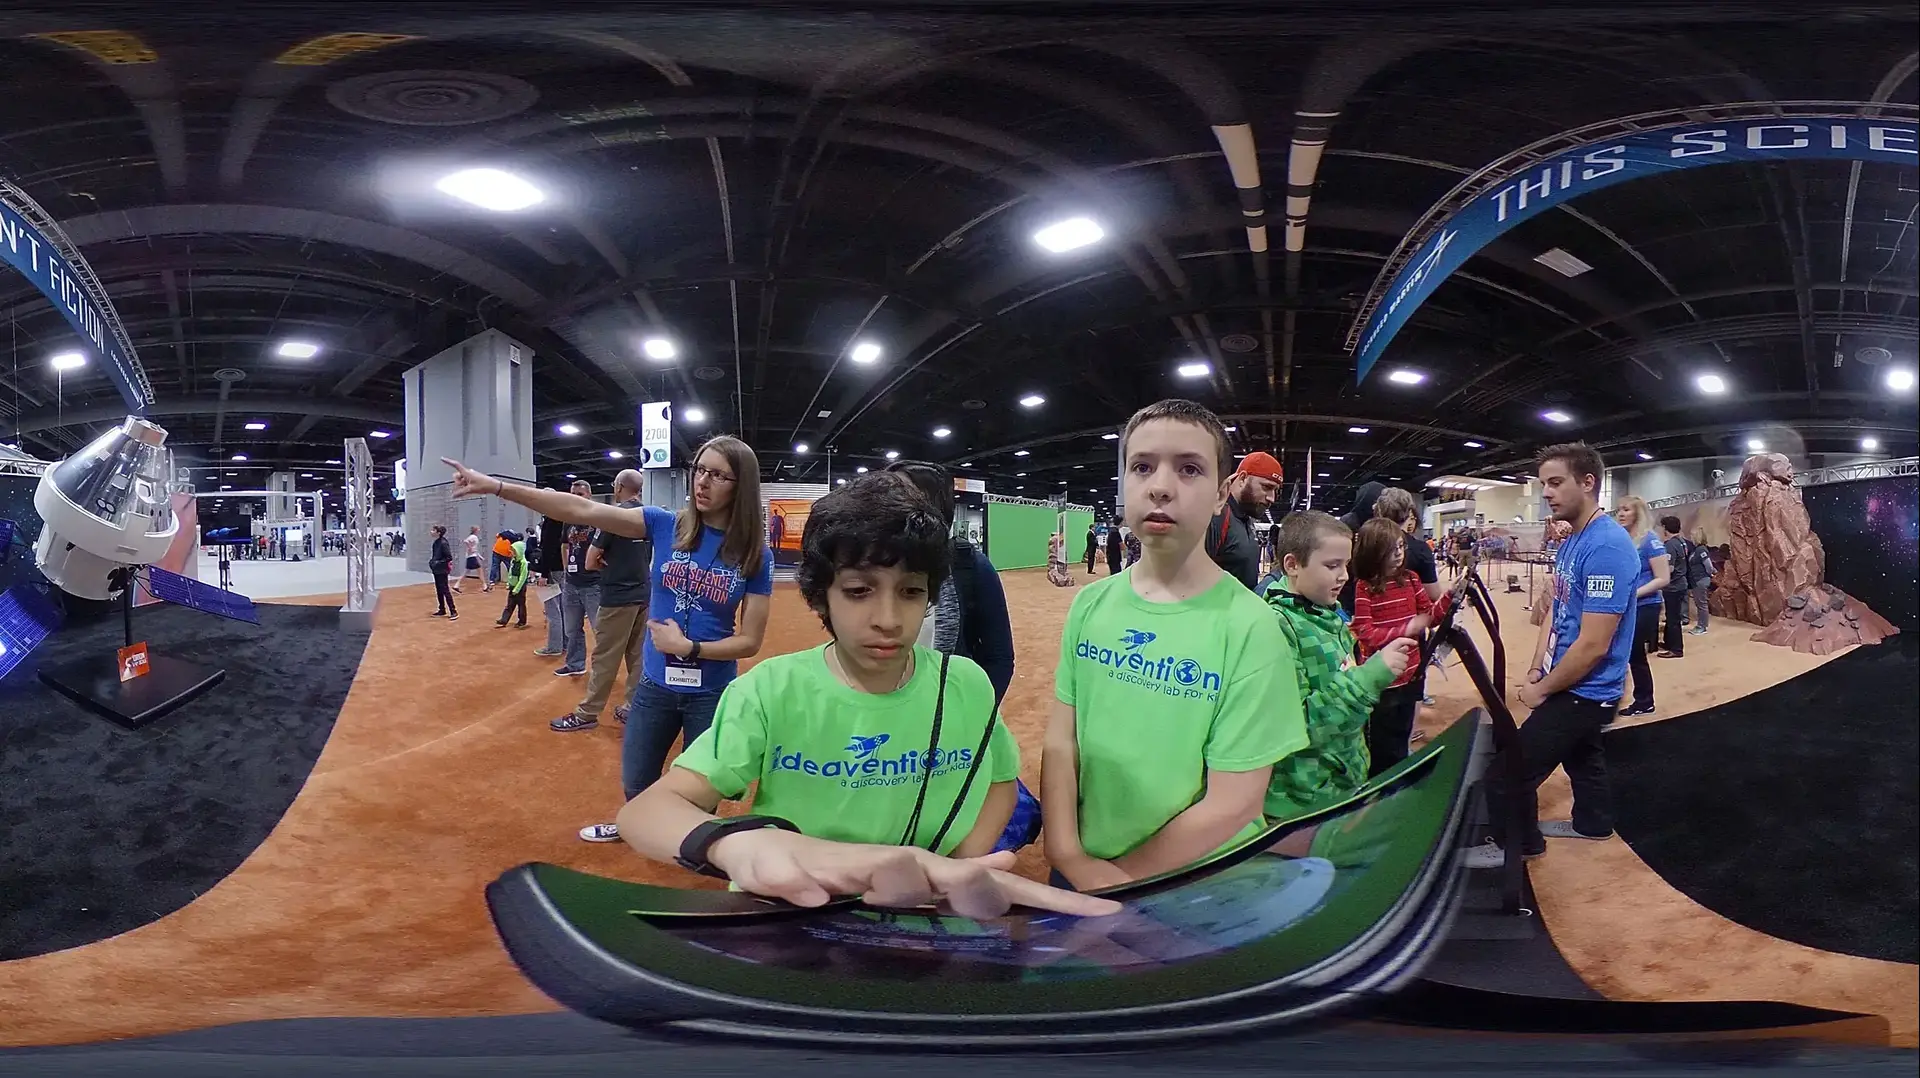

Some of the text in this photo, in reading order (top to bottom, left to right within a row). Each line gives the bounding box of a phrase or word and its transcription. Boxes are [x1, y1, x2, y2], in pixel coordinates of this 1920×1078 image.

[1491, 124, 1918, 222] THIS SCIE
[49, 255, 104, 354] FICTION
[645, 427, 668, 441] 2700
[662, 574, 729, 605] ISN'T FICTION
[689, 568, 731, 591] SCIENCE
[1588, 579, 1614, 591] BETTER
[1108, 669, 1114, 678] a
[1116, 671, 1161, 693] discovery
[1163, 685, 1180, 697] lab
[840, 779, 847, 788] a
[850, 775, 908, 789] discovery
